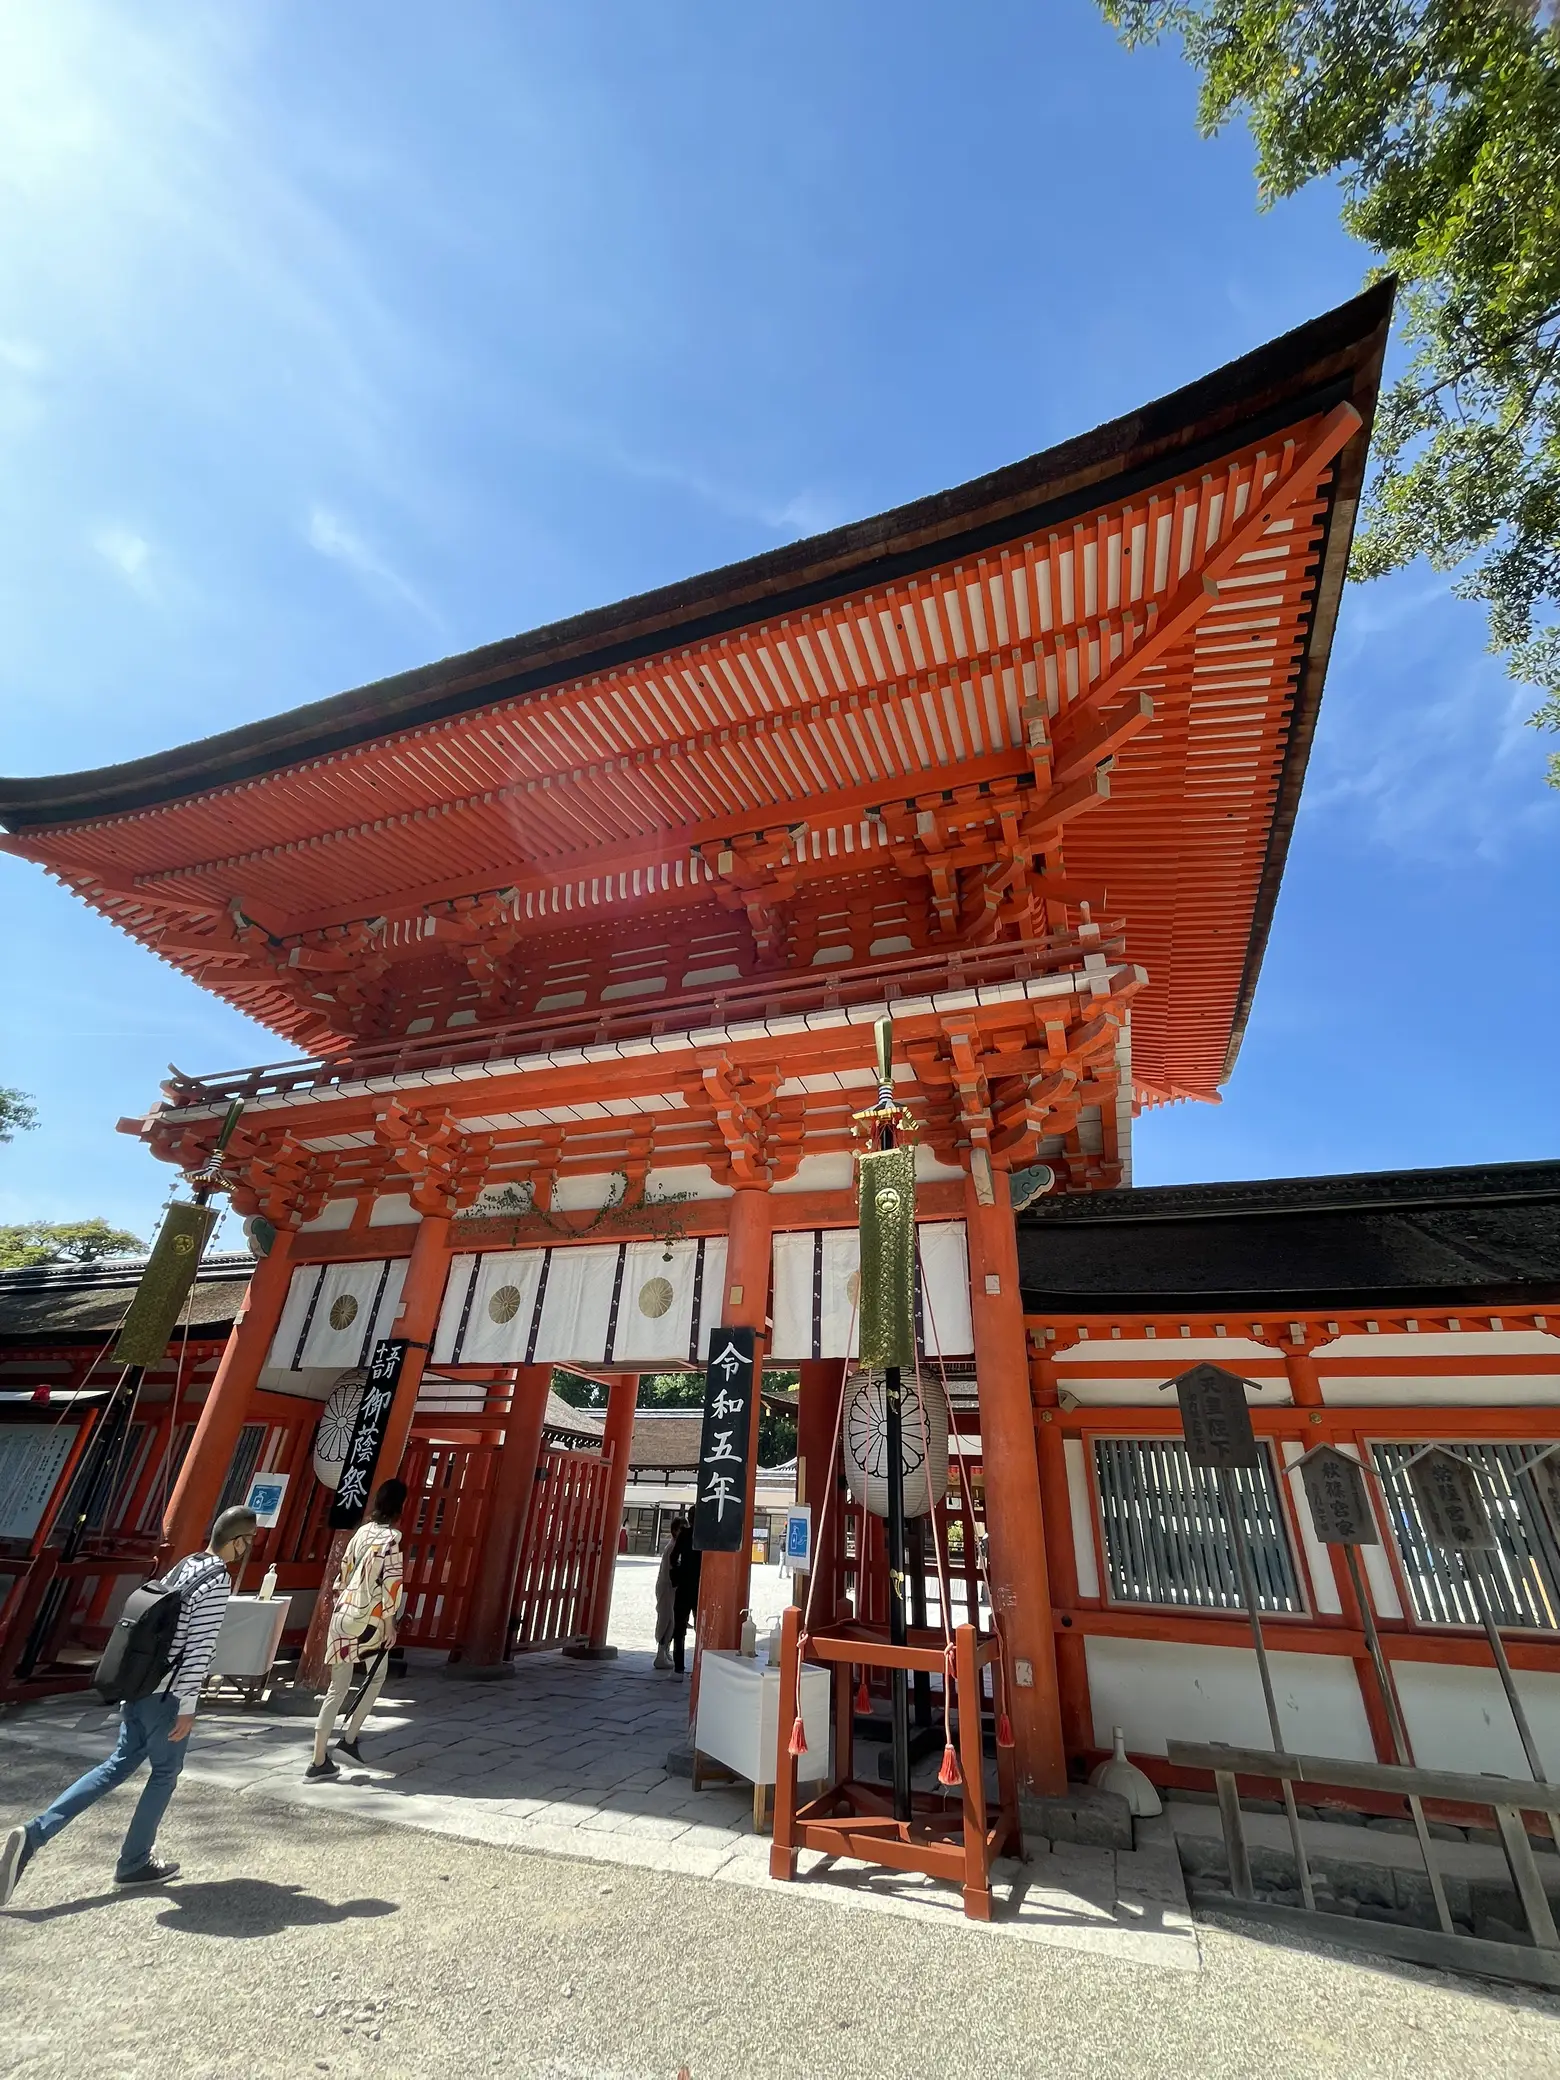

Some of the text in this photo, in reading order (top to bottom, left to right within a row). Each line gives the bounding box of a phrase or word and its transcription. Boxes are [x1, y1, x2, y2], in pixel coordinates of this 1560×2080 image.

[371, 1343, 388, 1380] 十二日
[382, 1345, 402, 1379] 五月
[337, 1386, 393, 1510] 御蔭祭
[701, 1341, 753, 1523] 令和五年
[1322, 1462, 1356, 1537] 秋篠宮家
